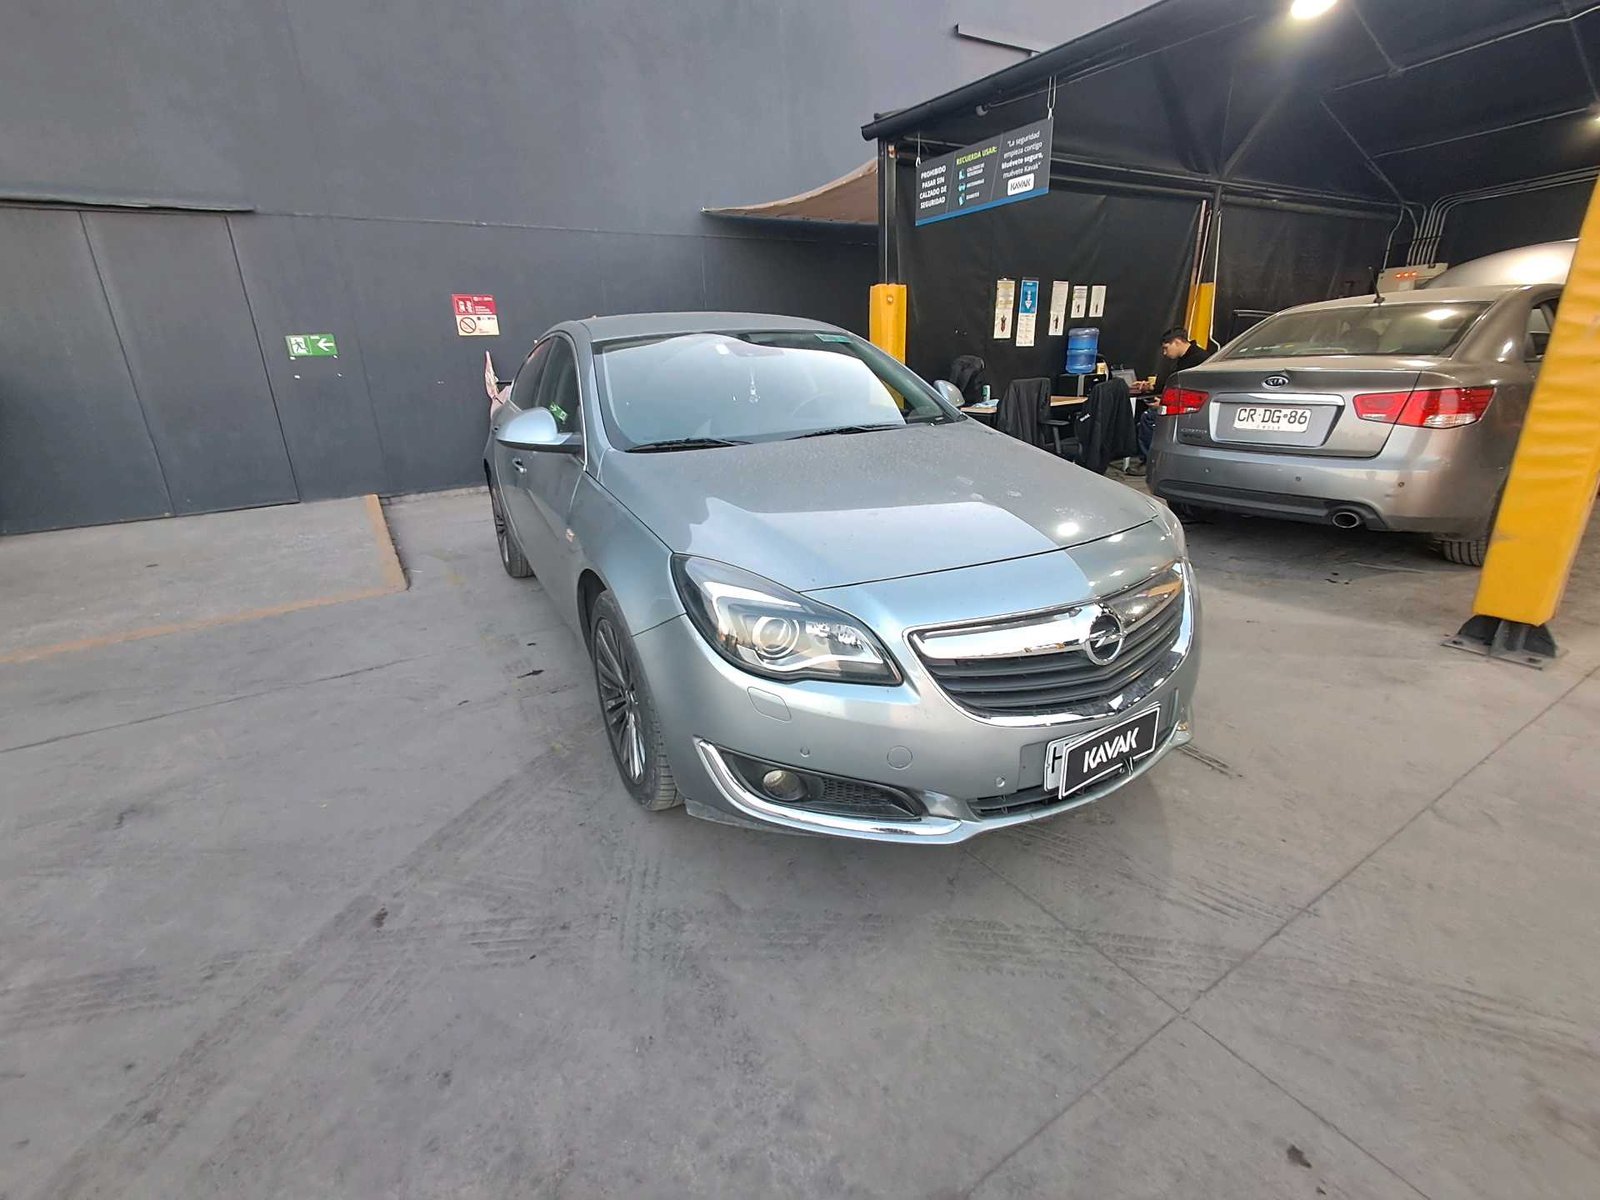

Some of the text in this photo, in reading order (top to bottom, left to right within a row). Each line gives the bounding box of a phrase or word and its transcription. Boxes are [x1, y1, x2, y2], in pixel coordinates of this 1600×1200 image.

[1016, 130, 1040, 145] seguridad
[921, 165, 946, 179] PROHIBIDO
[922, 176, 945, 189] PASAR SIN
[1010, 179, 1031, 191] KAVAK
[920, 185, 947, 199] CALZADO DE
[921, 196, 945, 209] SEGURIDAD
[1083, 727, 1139, 773] KAVAK
